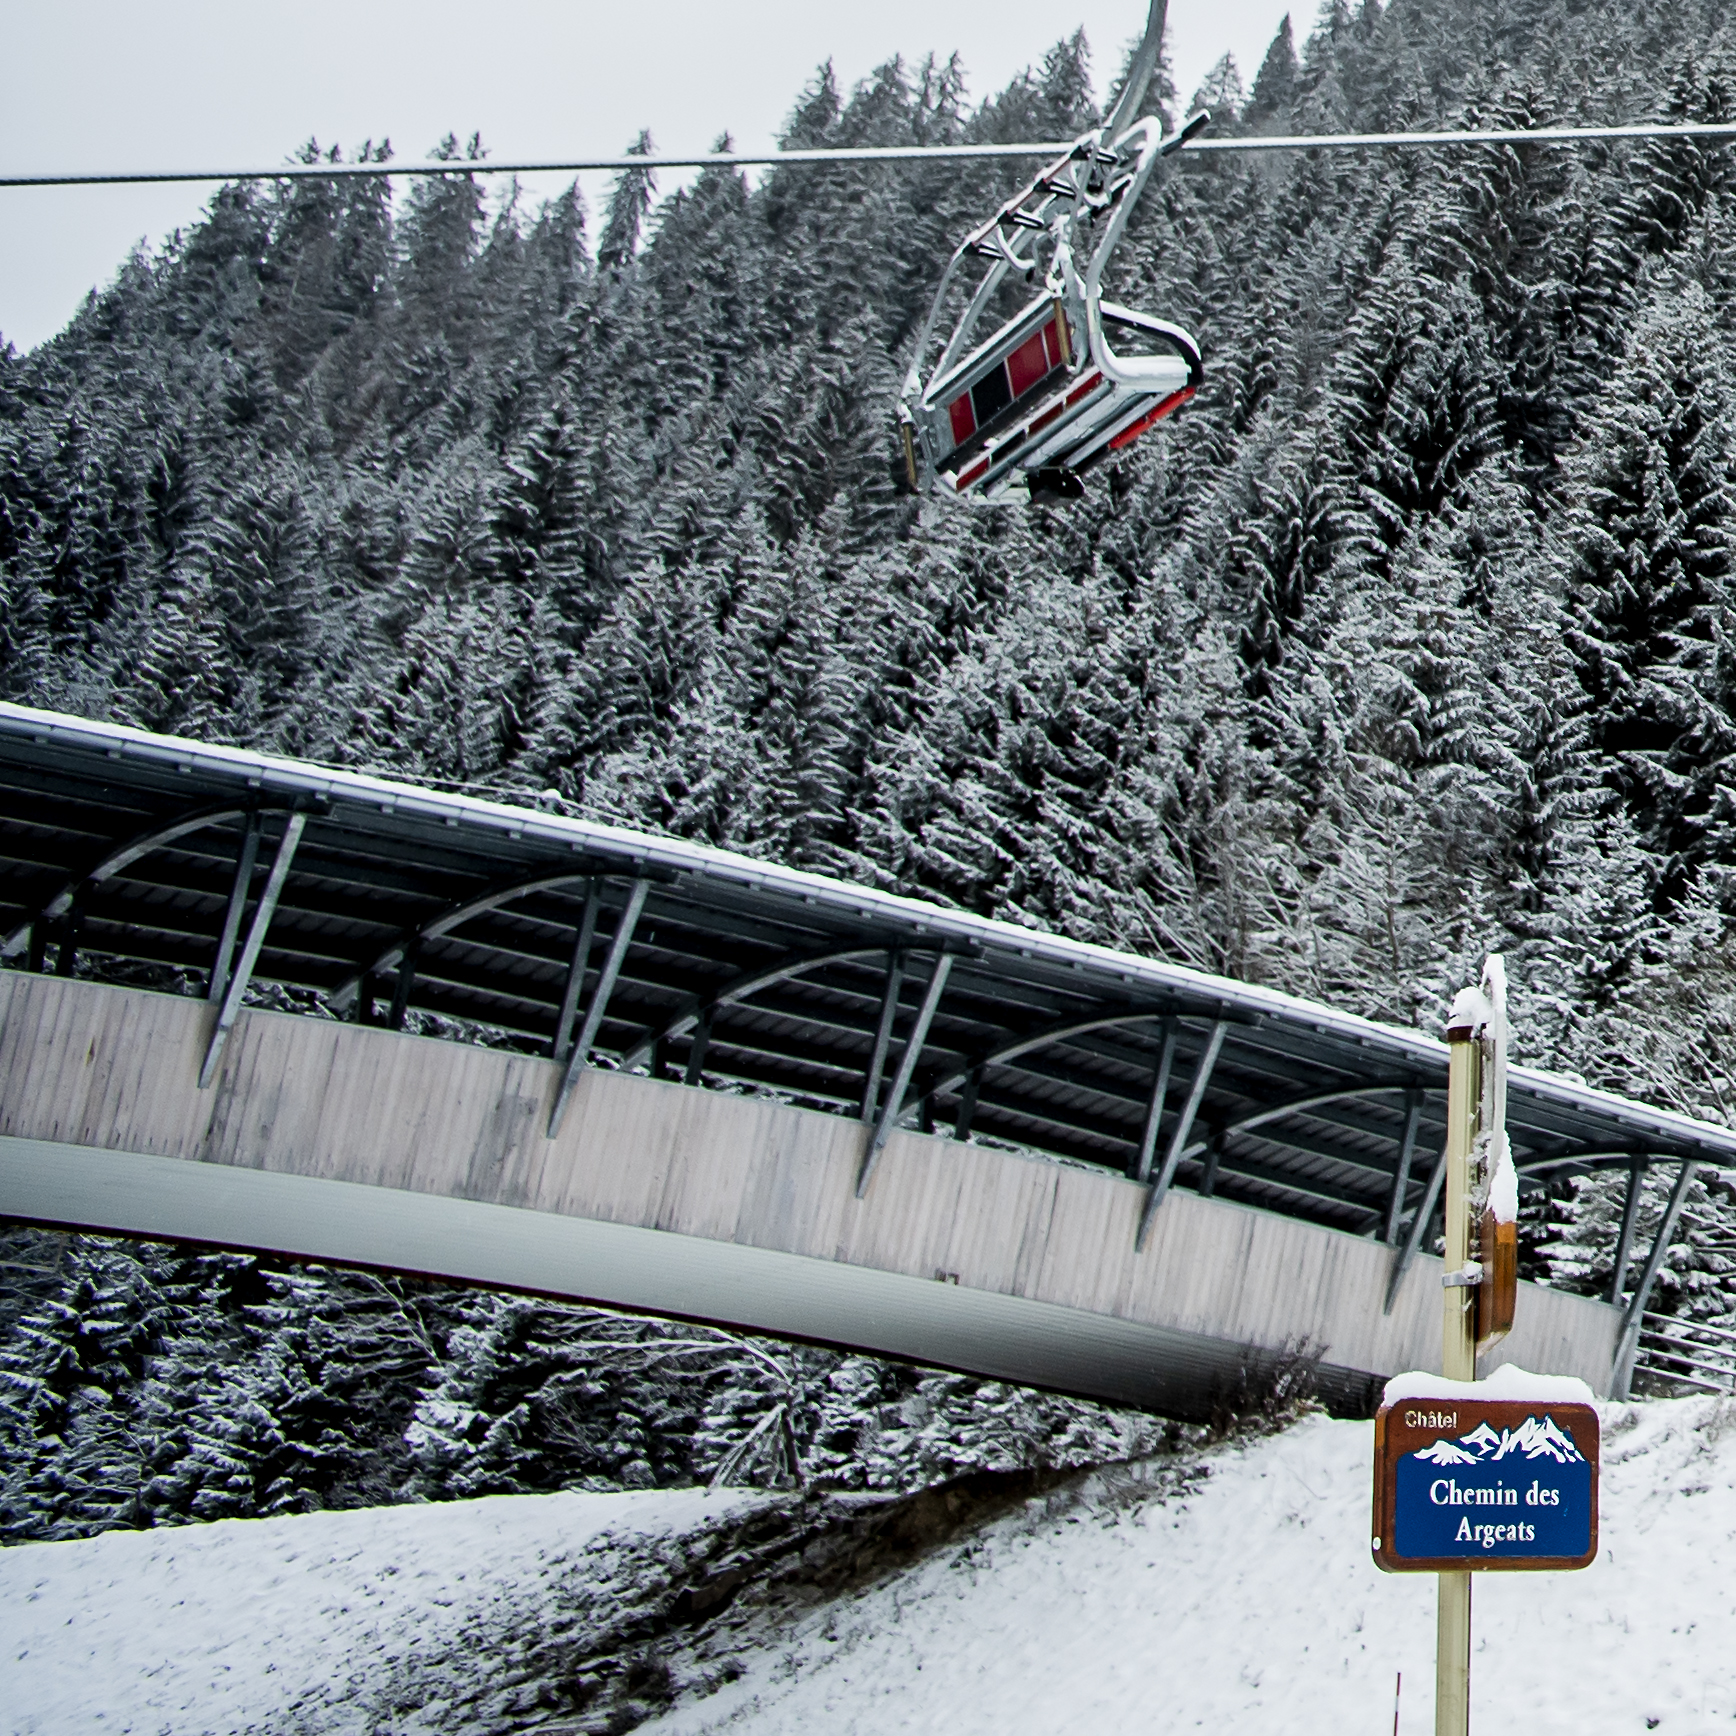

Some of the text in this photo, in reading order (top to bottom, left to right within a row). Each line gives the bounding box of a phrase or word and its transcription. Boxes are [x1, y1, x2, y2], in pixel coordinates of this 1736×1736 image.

[1404, 1410, 1458, 1429] Châtel
[1430, 1479, 1560, 1506] Chemin des
[1454, 1516, 1536, 1549] Argeats
